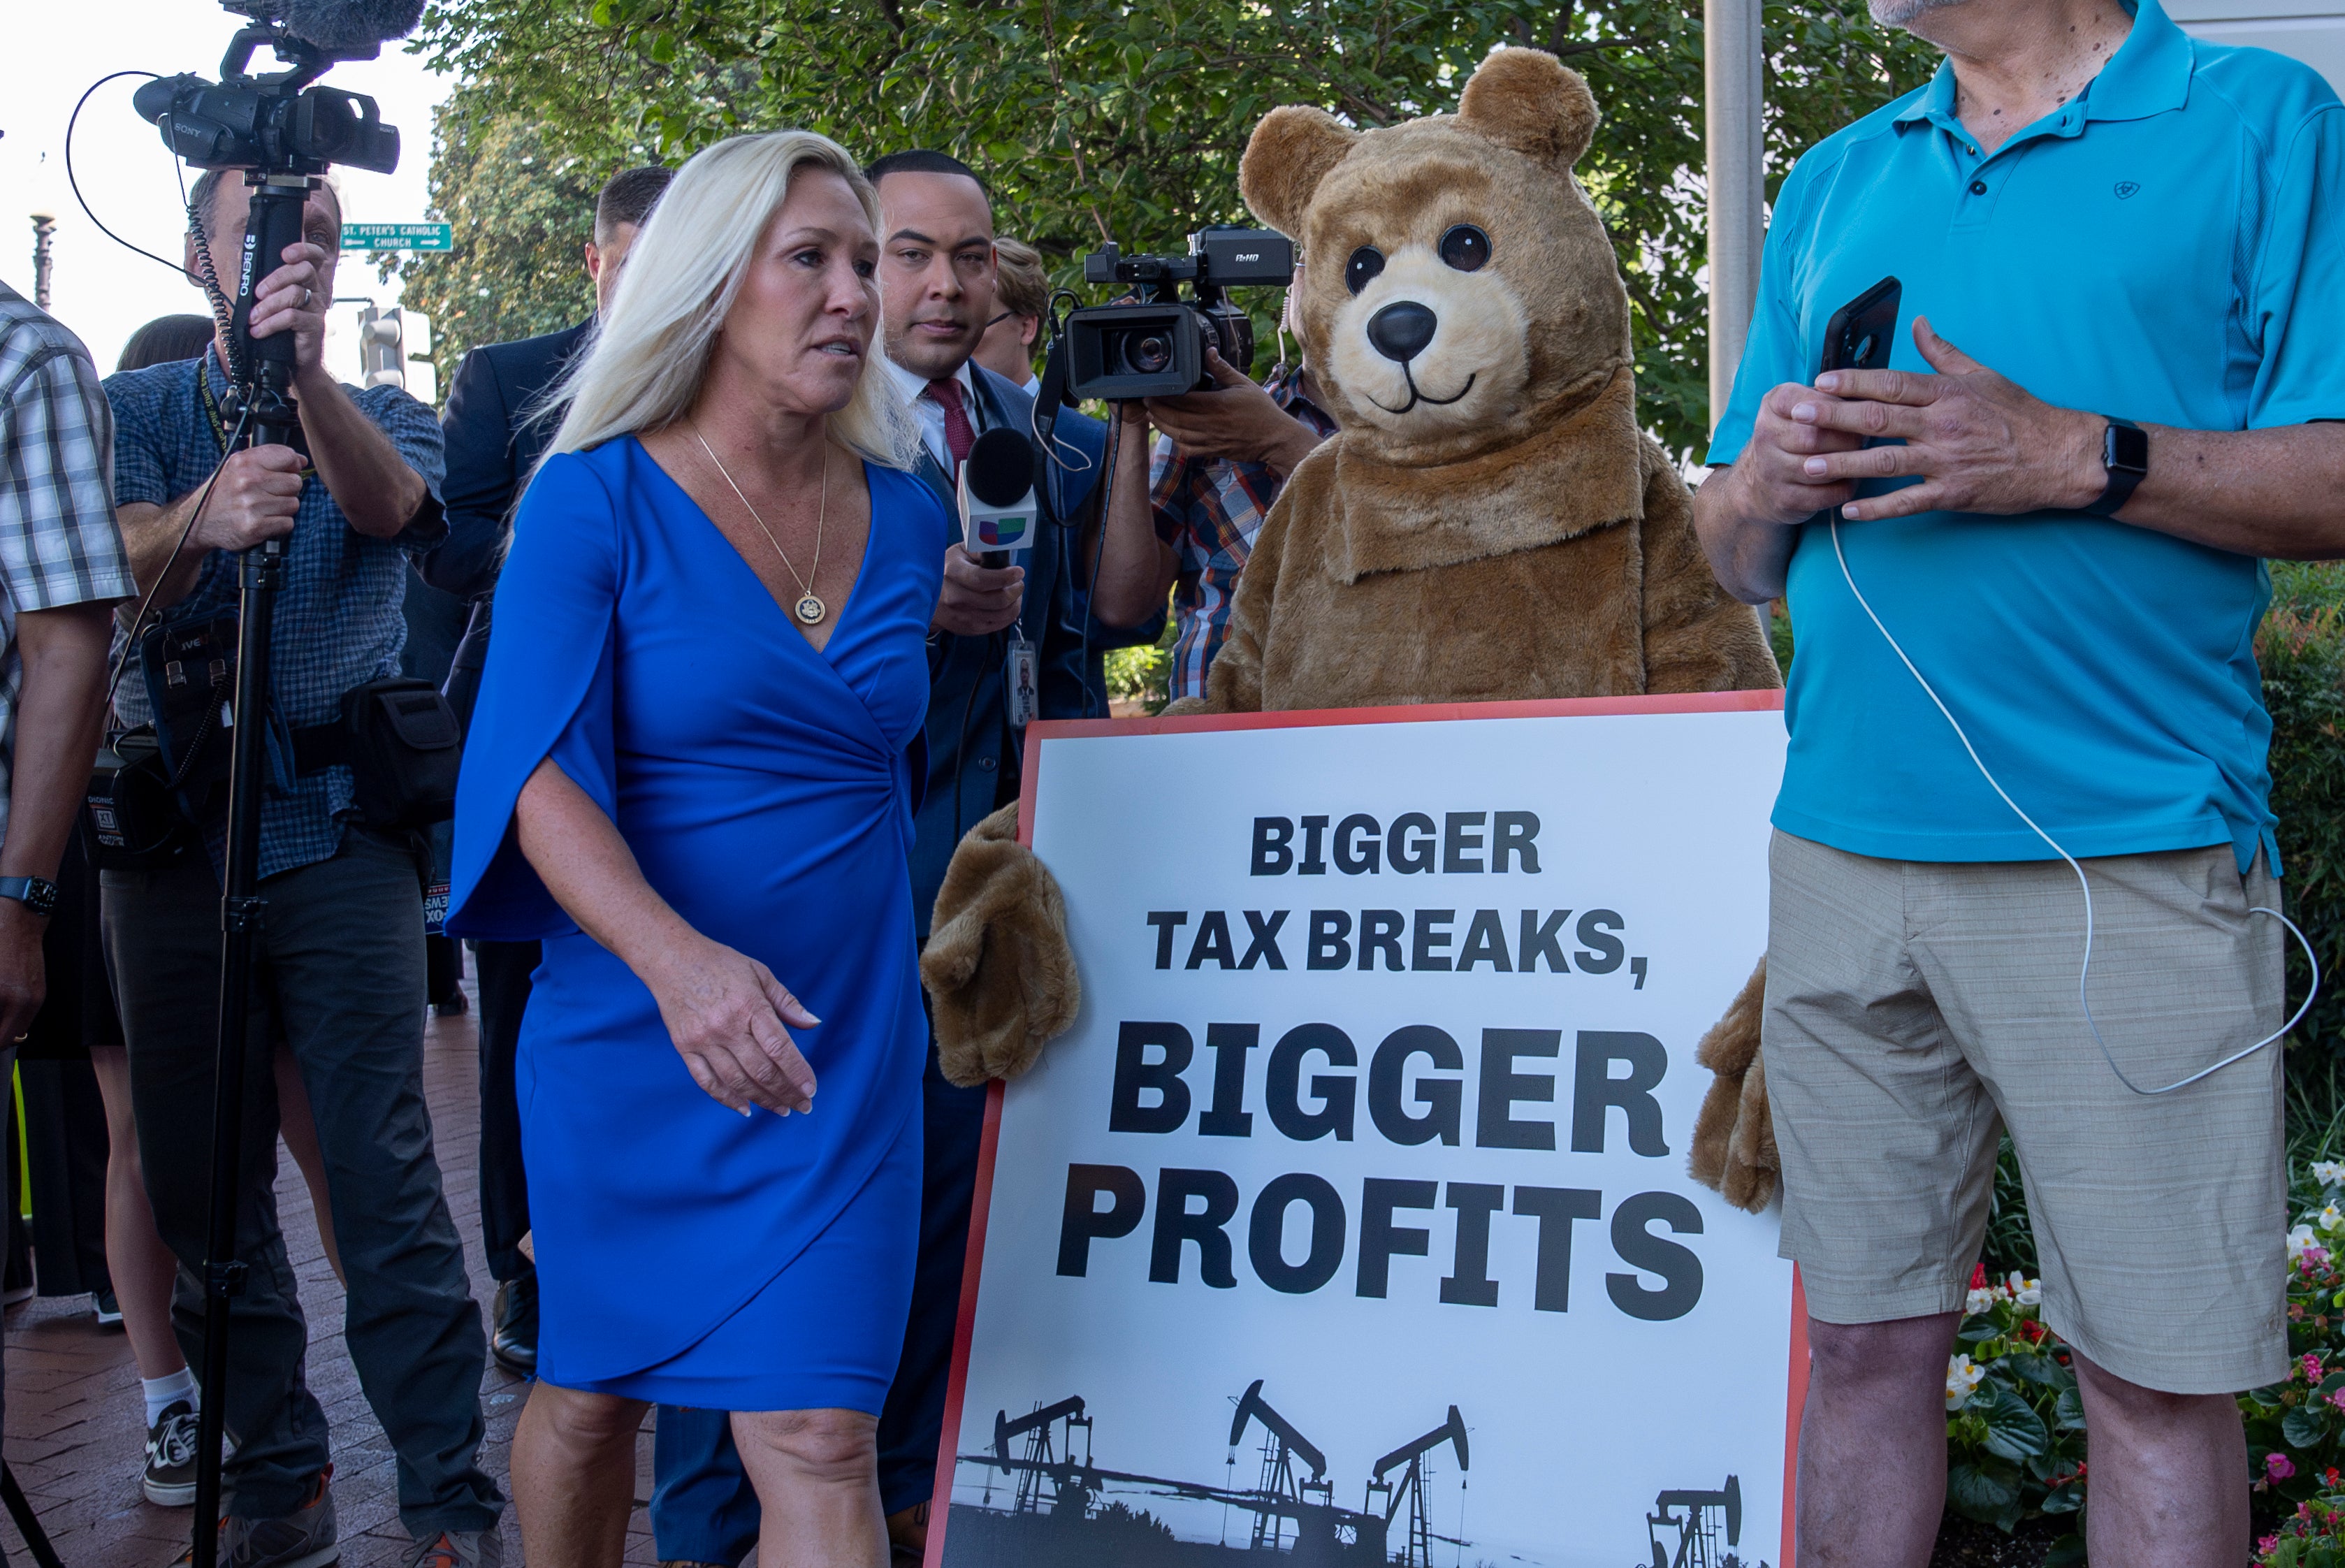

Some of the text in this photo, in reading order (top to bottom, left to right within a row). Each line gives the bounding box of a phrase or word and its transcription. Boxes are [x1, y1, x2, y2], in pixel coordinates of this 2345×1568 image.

[175, 123, 201, 137] SONY
[343, 225, 441, 236] ST. PETER'S CATHOLIC
[373, 238, 412, 248] CHURCH
[240, 252, 253, 296] BENRO
[1250, 811, 1542, 876] BIGGER
[424, 895, 449, 910] EWS
[1147, 909, 1648, 990] TAX BREAKS,
[1108, 1020, 1670, 1158] BIGGER
[1055, 1162, 1704, 1321] PROFITS
